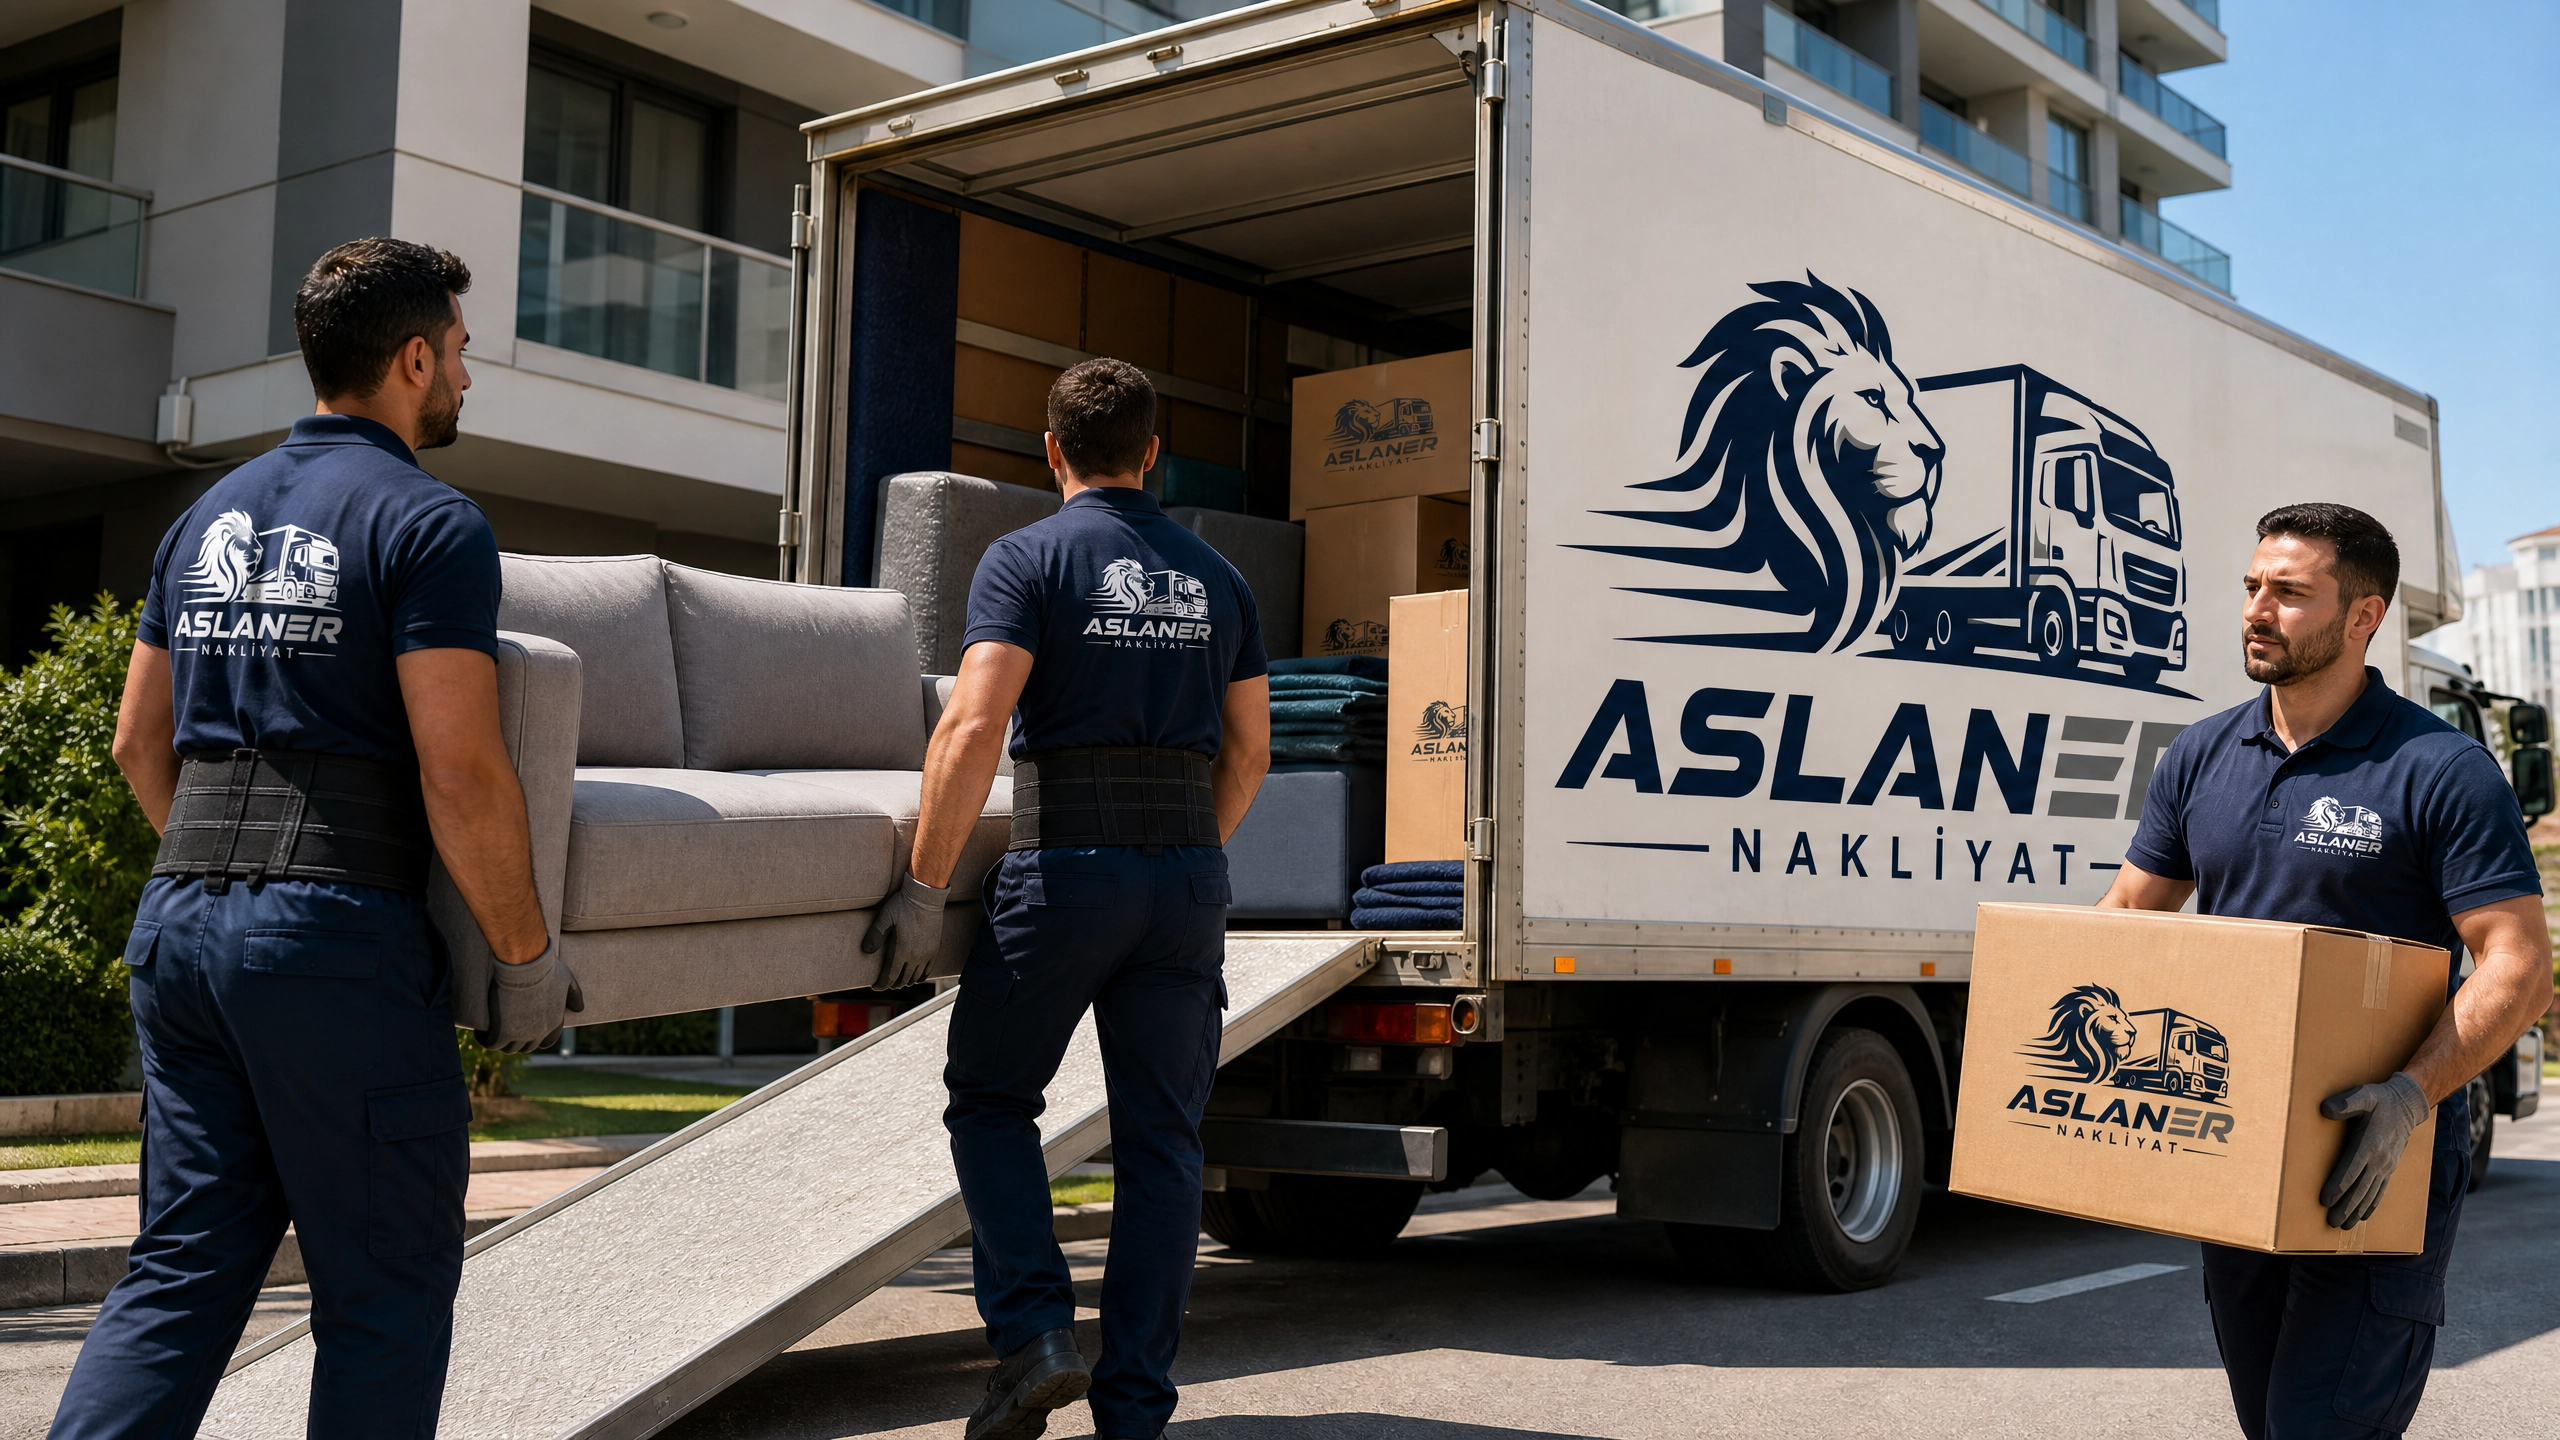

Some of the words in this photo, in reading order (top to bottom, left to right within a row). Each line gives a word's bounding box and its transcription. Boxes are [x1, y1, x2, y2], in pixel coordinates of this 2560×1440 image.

[1324, 436, 1438, 467] ASLANER
[174, 611, 344, 644] ASLANER
[1082, 618, 1212, 641] ASLANER
[201, 643, 294, 659] NAKLİYAT
[1411, 741, 1467, 755] ASLAN
[1732, 826, 2075, 885] NAKLİYAT
[2294, 831, 2383, 854] ASLANER
[2006, 1084, 2235, 1144] ASLANER
[2057, 1123, 2178, 1155] NAKLİYAT
